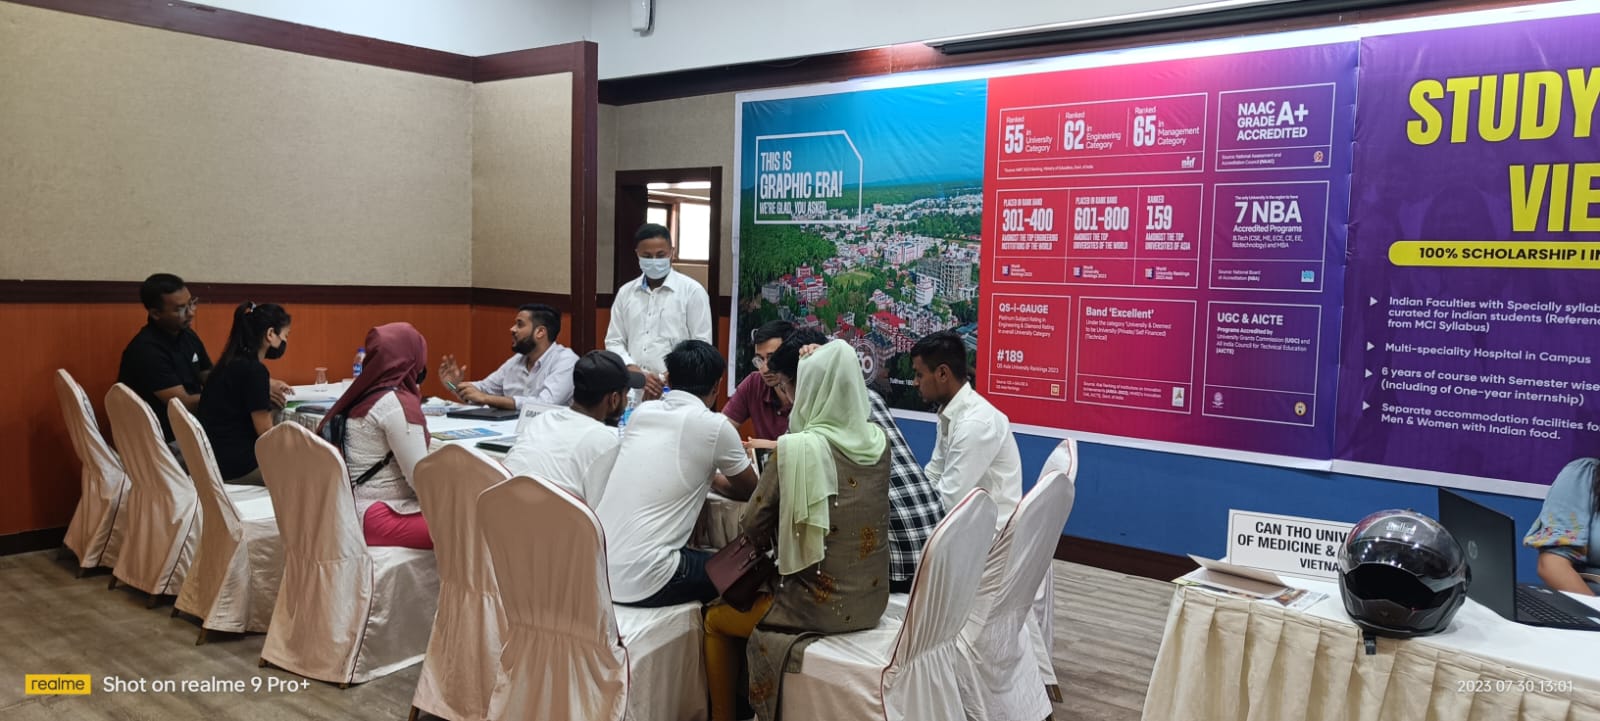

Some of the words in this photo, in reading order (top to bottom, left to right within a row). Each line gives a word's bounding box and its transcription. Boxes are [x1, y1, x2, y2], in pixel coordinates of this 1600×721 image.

[1238, 101, 1275, 116] NAAC
[1276, 101, 1308, 126] A+
[1406, 68, 1600, 146] STUDY
[1133, 115, 1156, 147] 65
[1158, 126, 1199, 137] Management
[1237, 116, 1275, 128] GRADE
[1005, 124, 1024, 154] 55
[1064, 119, 1085, 150] 62
[1086, 132, 1121, 142] Engineering
[1158, 138, 1186, 146] Category
[1236, 127, 1308, 141] ACCREDITED
[1025, 145, 1050, 153] Category
[1086, 142, 1113, 150] Category
[761, 152, 780, 171] THIS
[782, 151, 792, 170] IS
[760, 172, 812, 199] GRAPHIC
[815, 171, 843, 198] ERA!
[1509, 162, 1600, 232] VIE
[777, 202, 792, 215] GLAD,
[794, 201, 806, 214] YOU
[1146, 205, 1172, 230] 159
[1235, 201, 1248, 223] 7
[1252, 200, 1302, 223] NBA
[1002, 208, 1053, 232] 301-400
[1074, 206, 1129, 231] 601-800
[1233, 224, 1268, 232] Accredited
[1270, 224, 1302, 234] Programs
[1420, 248, 1458, 259] 100%
[1462, 248, 1577, 260] SCHOLARSHIP
[999, 303, 1049, 314] QS-i-GAUGE
[1086, 306, 1107, 317] Band
[1389, 296, 1423, 306] Indian
[1426, 298, 1476, 308] Faculties
[1479, 300, 1503, 309] with
[1507, 301, 1562, 313] Specially
[1217, 312, 1239, 322] UGC
[1242, 314, 1249, 323] &
[1251, 314, 1283, 325] AICTE
[1388, 309, 1430, 318] curated
[1434, 310, 1448, 318] for
[1490, 313, 1542, 322] students
[1388, 319, 1412, 328] from
[1415, 320, 1436, 329] MCI
[1439, 321, 1490, 333] Syllabus)
[997, 349, 1024, 362] #189
[1385, 343, 1471, 358] Multi-speciality
[1474, 348, 1522, 360] Hospital
[1525, 351, 1536, 360] in
[1540, 352, 1591, 365] Campus
[1382, 367, 1388, 375] 6
[1391, 368, 1422, 378] years
[1424, 370, 1436, 378] of
[1438, 372, 1477, 381] course
[1480, 374, 1505, 384] with
[1508, 376, 1568, 388] Semester
[1571, 381, 1600, 391] wise
[1381, 378, 1437, 395] (Including
[1440, 385, 1451, 394] of
[1454, 386, 1512, 400] One-year
[1514, 390, 1584, 406] internship)
[1381, 414, 1403, 424] Men
[1406, 416, 1414, 425] &
[1417, 417, 1458, 429] Women
[1462, 422, 1485, 432] with
[1489, 424, 1526, 436] Indian
[1529, 428, 1561, 439] food.
[1382, 403, 1431, 416] Separate
[1434, 409, 1529, 425] accommodation
[1532, 416, 1583, 430] facilities
[1587, 422, 1600, 431] fo
[1255, 522, 1282, 535] CAN
[1286, 525, 1312, 539] THO
[1316, 529, 1348, 543] UNIV
[1237, 534, 1254, 547] OF
[1258, 537, 1322, 555] MEDICINE
[1325, 545, 1335, 557] &
[1300, 558, 1340, 572] VIETNA
